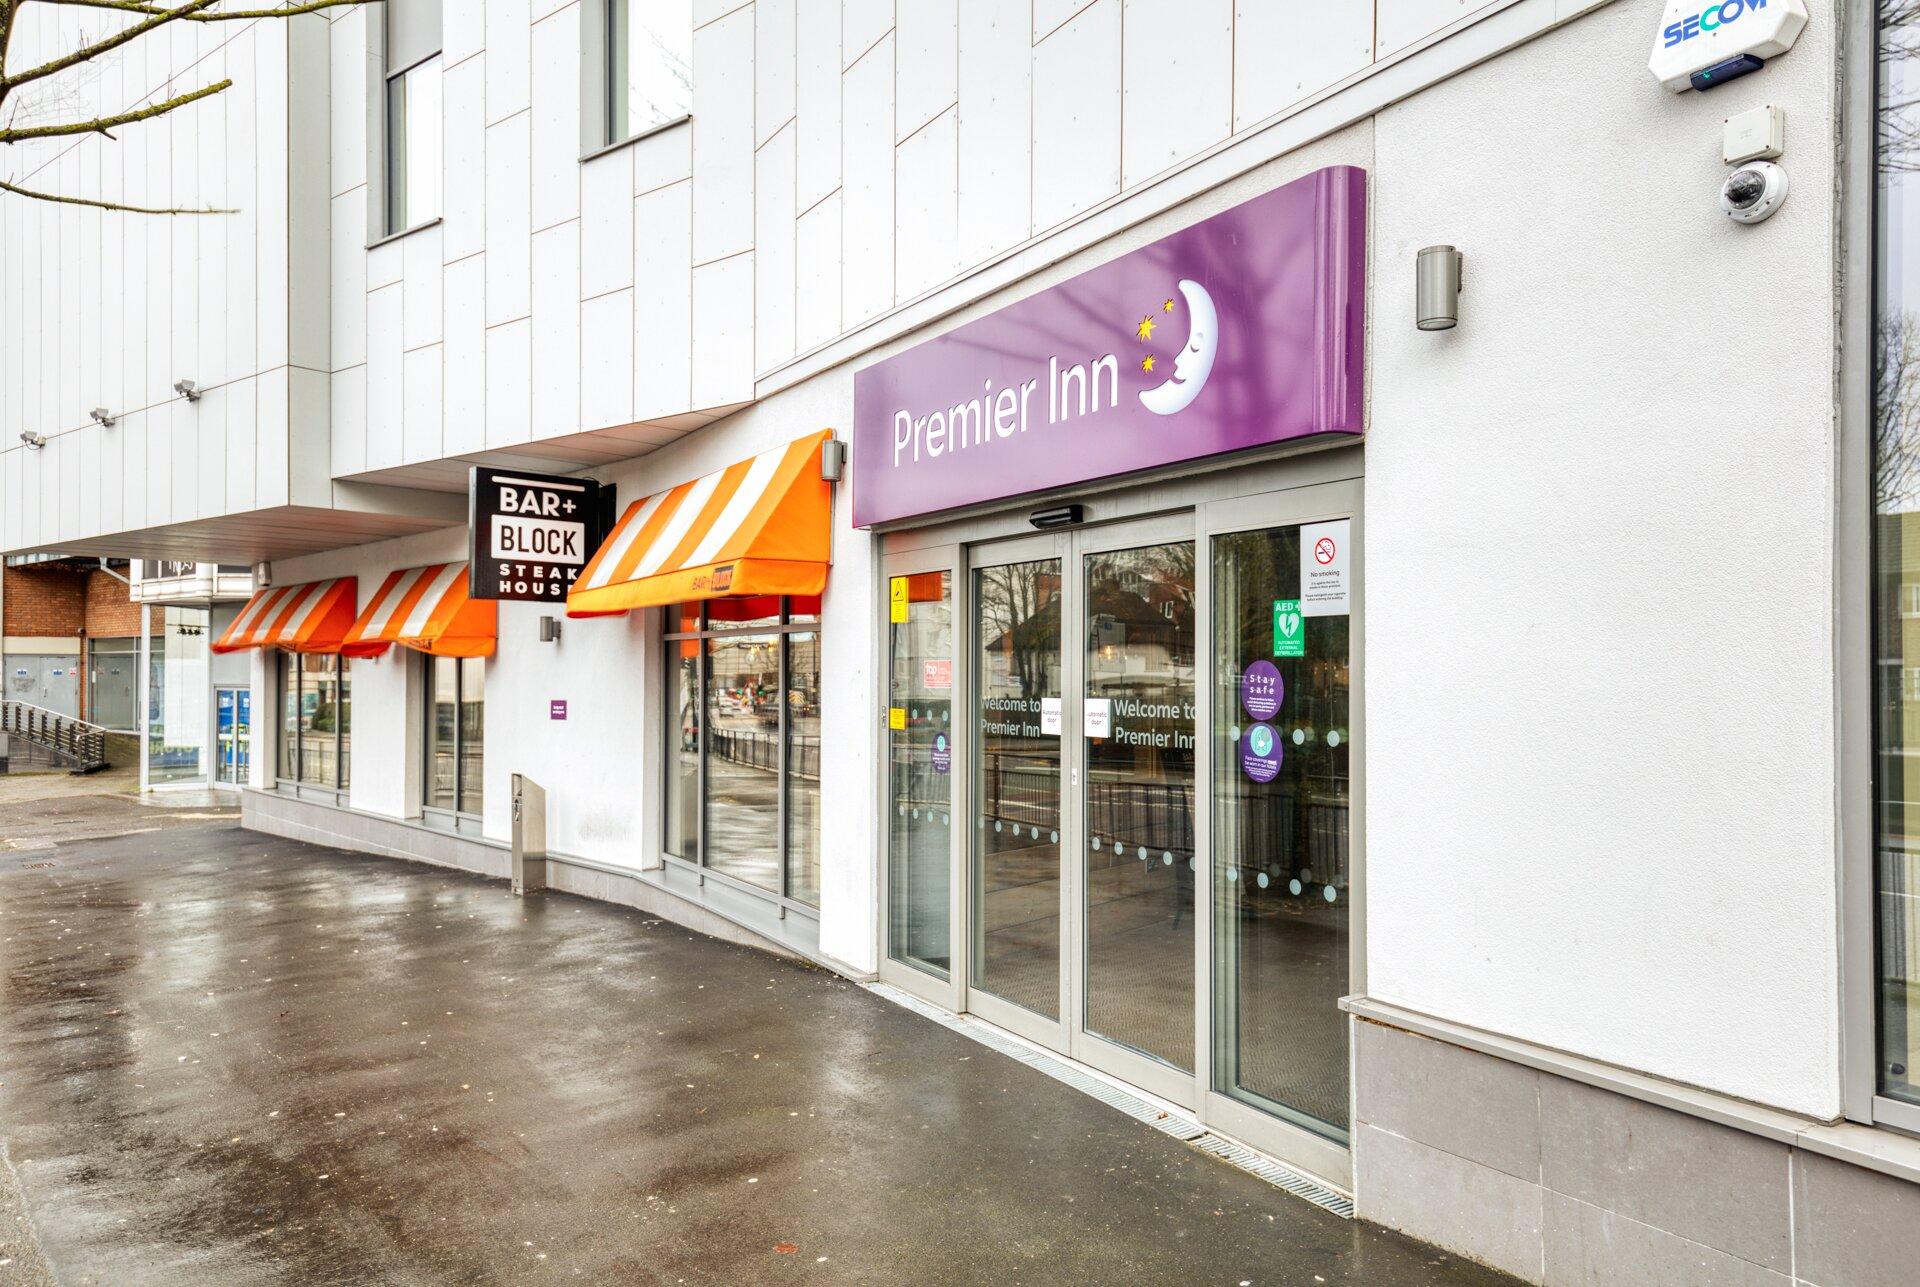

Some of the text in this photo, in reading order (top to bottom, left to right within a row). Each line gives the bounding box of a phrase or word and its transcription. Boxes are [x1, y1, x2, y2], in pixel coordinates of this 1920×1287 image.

[893, 354, 1118, 468] Premier Inn
[500, 486, 577, 517] BAR+
[500, 525, 577, 557] BLOCK
[499, 563, 578, 580] STEAK
[1275, 602, 1294, 611] AED
[1029, 698, 1041, 712] to
[1114, 699, 1180, 719] Welcome
[980, 718, 1040, 738] Premier Inn
[1116, 726, 1171, 748] Premier
